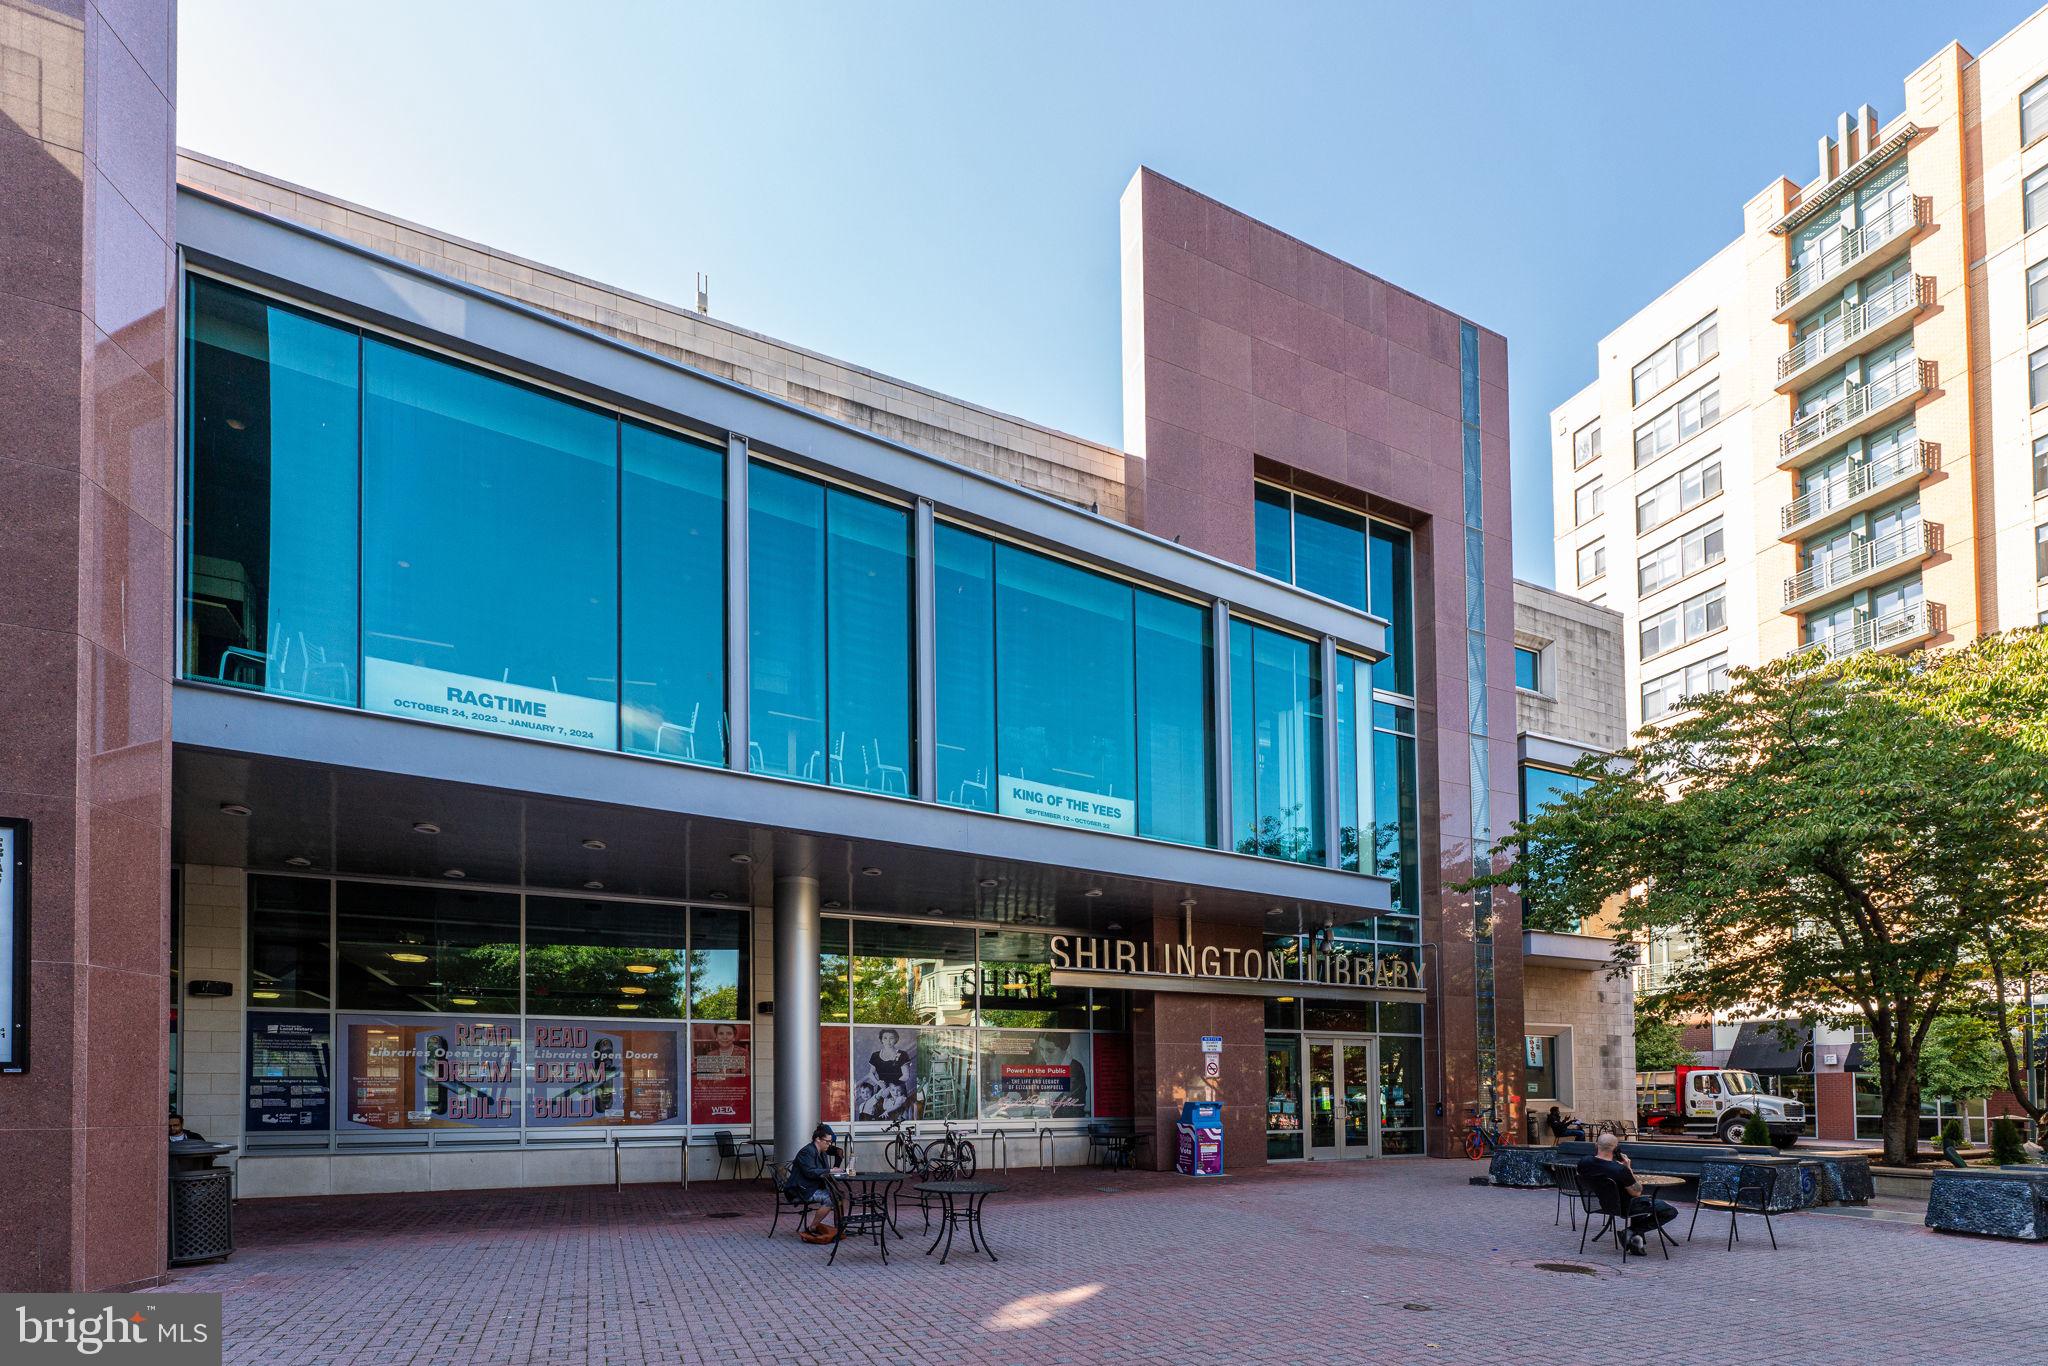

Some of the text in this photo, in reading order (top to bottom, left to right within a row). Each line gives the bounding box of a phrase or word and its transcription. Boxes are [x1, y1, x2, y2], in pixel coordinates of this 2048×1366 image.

[447, 686, 547, 718] RAGTIME
[393, 698, 449, 715] OCTOBER
[451, 708, 469, 720] 24,
[471, 712, 498, 723] 2023
[508, 718, 555, 733] JANUARY
[558, 727, 567, 737] 7,
[569, 729, 594, 739] 2024
[1012, 787, 1122, 819] KING OF THE YEES
[1025, 808, 1061, 820] SEPTEMBER
[1074, 818, 1102, 827] OCTOBER
[1050, 935, 1427, 990] SHIRLINGTON LIBRARY
[455, 1024, 512, 1047] READ
[535, 1026, 588, 1049] READ
[369, 1047, 511, 1059] Libraries Open Doors
[534, 1050, 659, 1061] Libraries Open Doors
[433, 1060, 512, 1083] DREAM
[535, 1061, 607, 1085] DREAM
[448, 1097, 512, 1120] BUILD
[535, 1097, 594, 1119] BUILD
[711, 1106, 734, 1114] WETA
